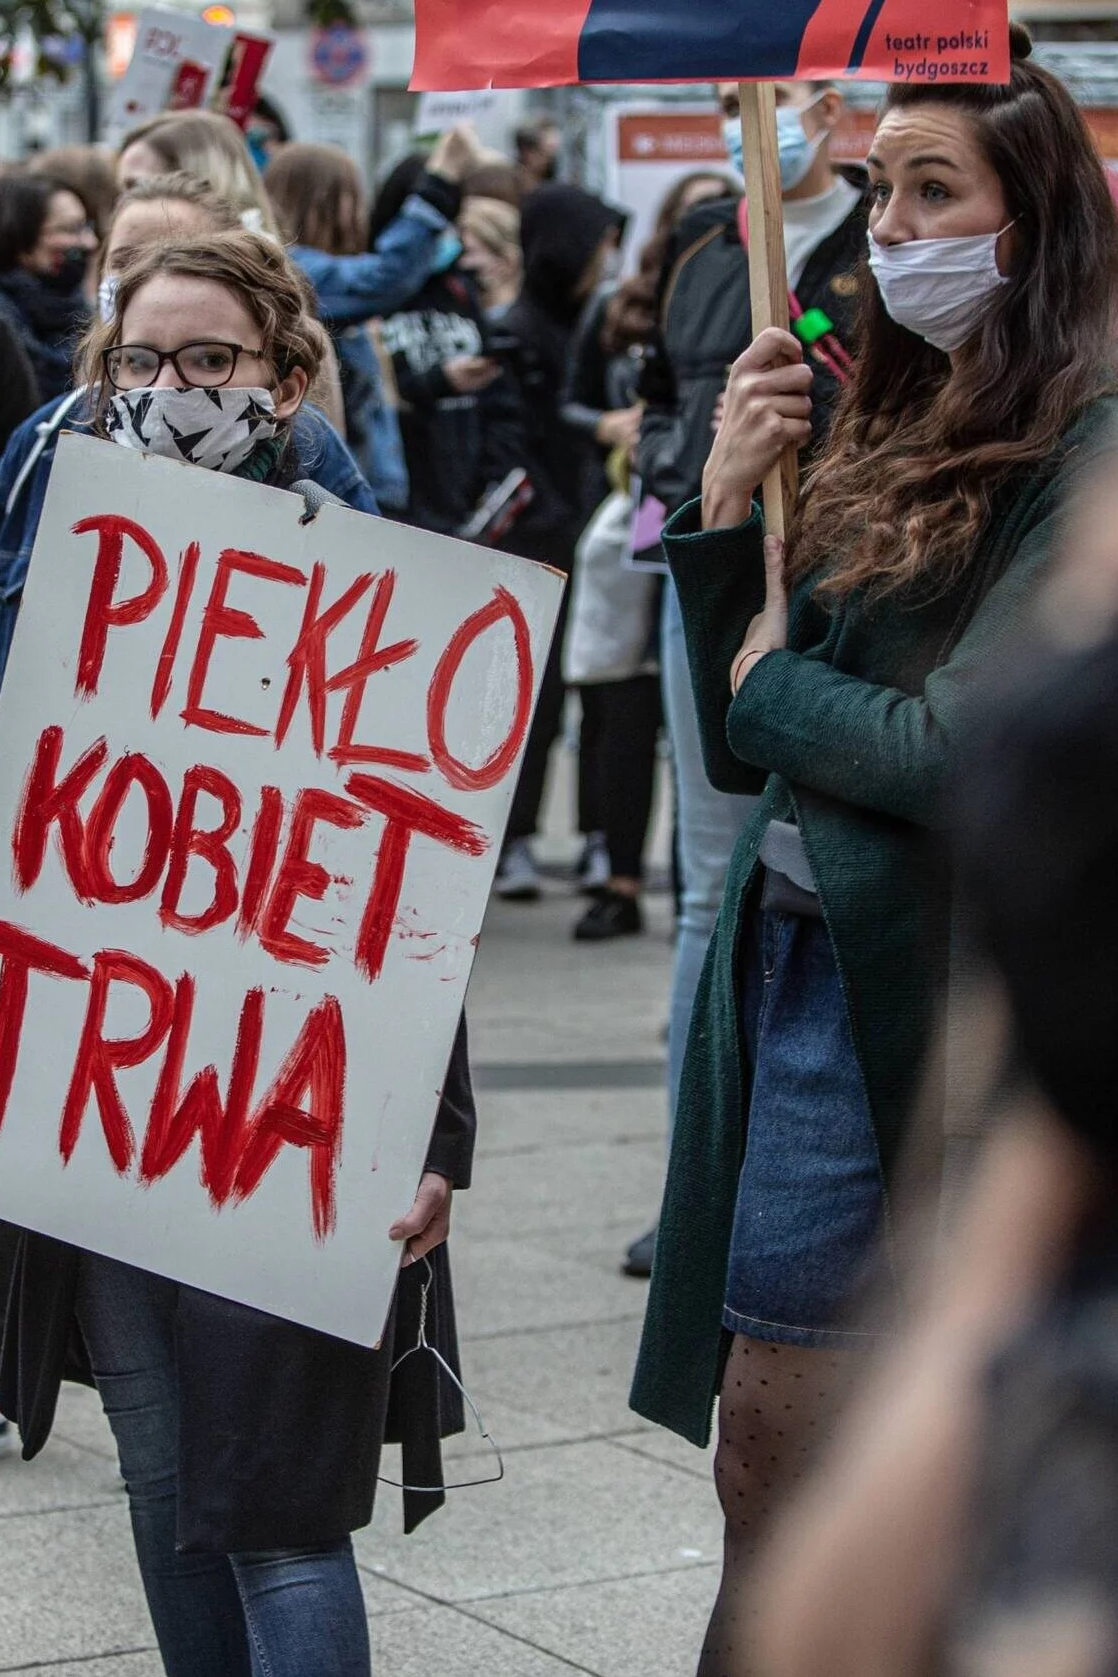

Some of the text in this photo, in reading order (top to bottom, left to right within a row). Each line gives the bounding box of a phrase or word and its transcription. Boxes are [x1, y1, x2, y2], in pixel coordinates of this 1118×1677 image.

[885, 30, 988, 54] teatr polski
[894, 57, 989, 80] bydgoszcz
[72, 514, 533, 791] PIEKŁO
[11, 724, 492, 985] KOBIET
